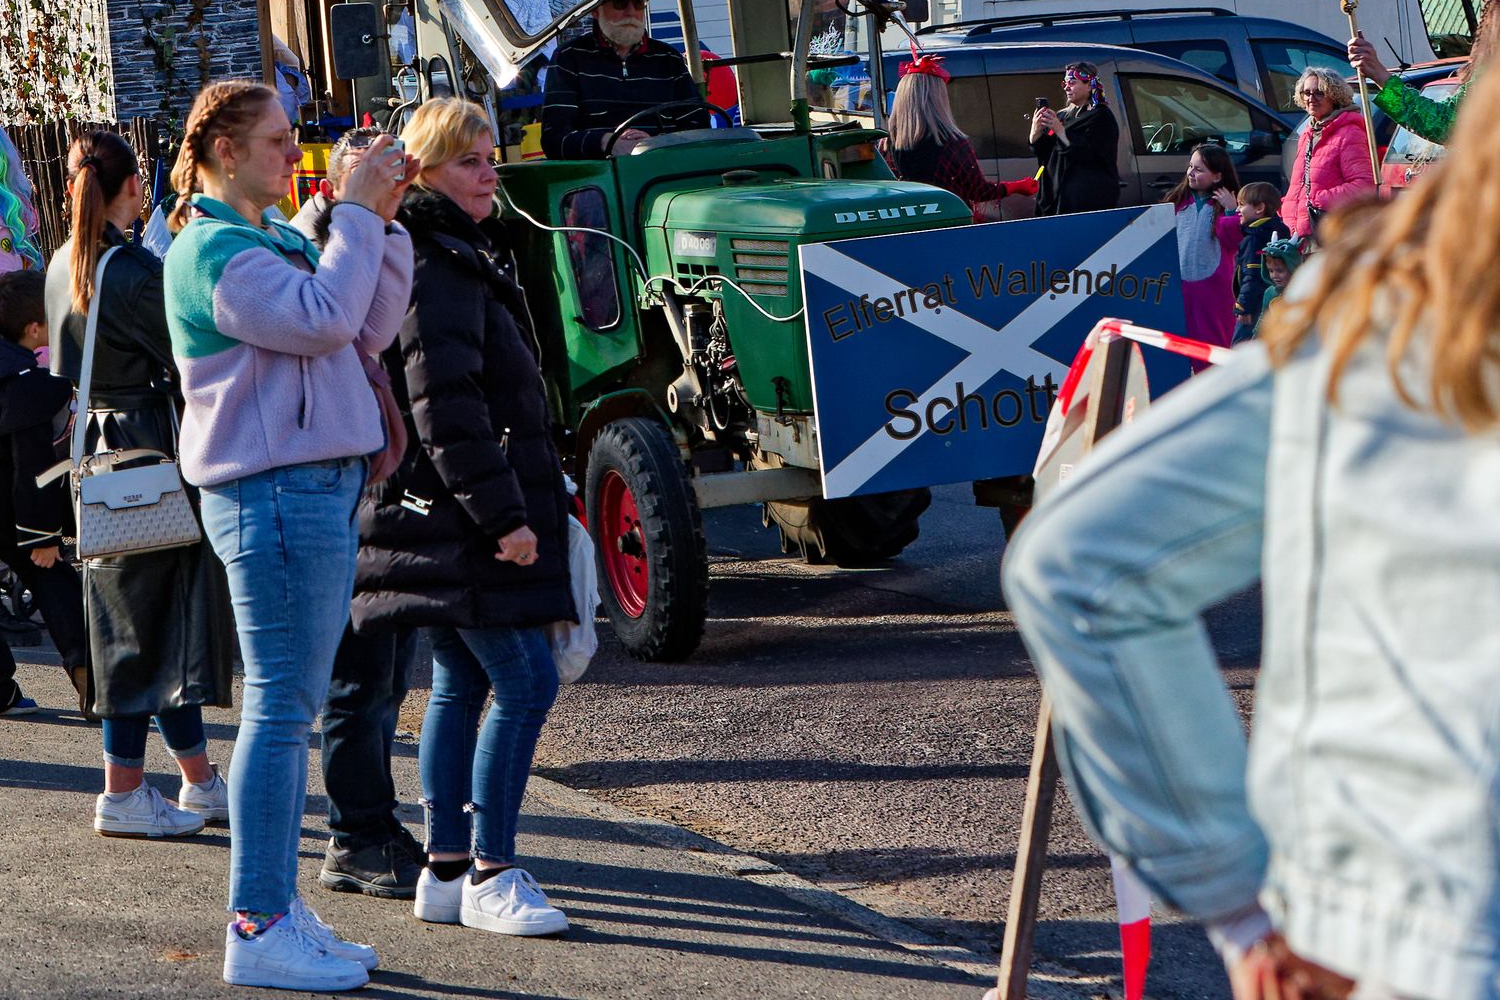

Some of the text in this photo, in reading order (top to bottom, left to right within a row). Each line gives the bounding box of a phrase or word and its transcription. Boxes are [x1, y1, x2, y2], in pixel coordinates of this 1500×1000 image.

[834, 203, 942, 223] DEUTZ
[823, 261, 1172, 342] Elferrat Wallendorf
[884, 374, 1059, 441] Schott
